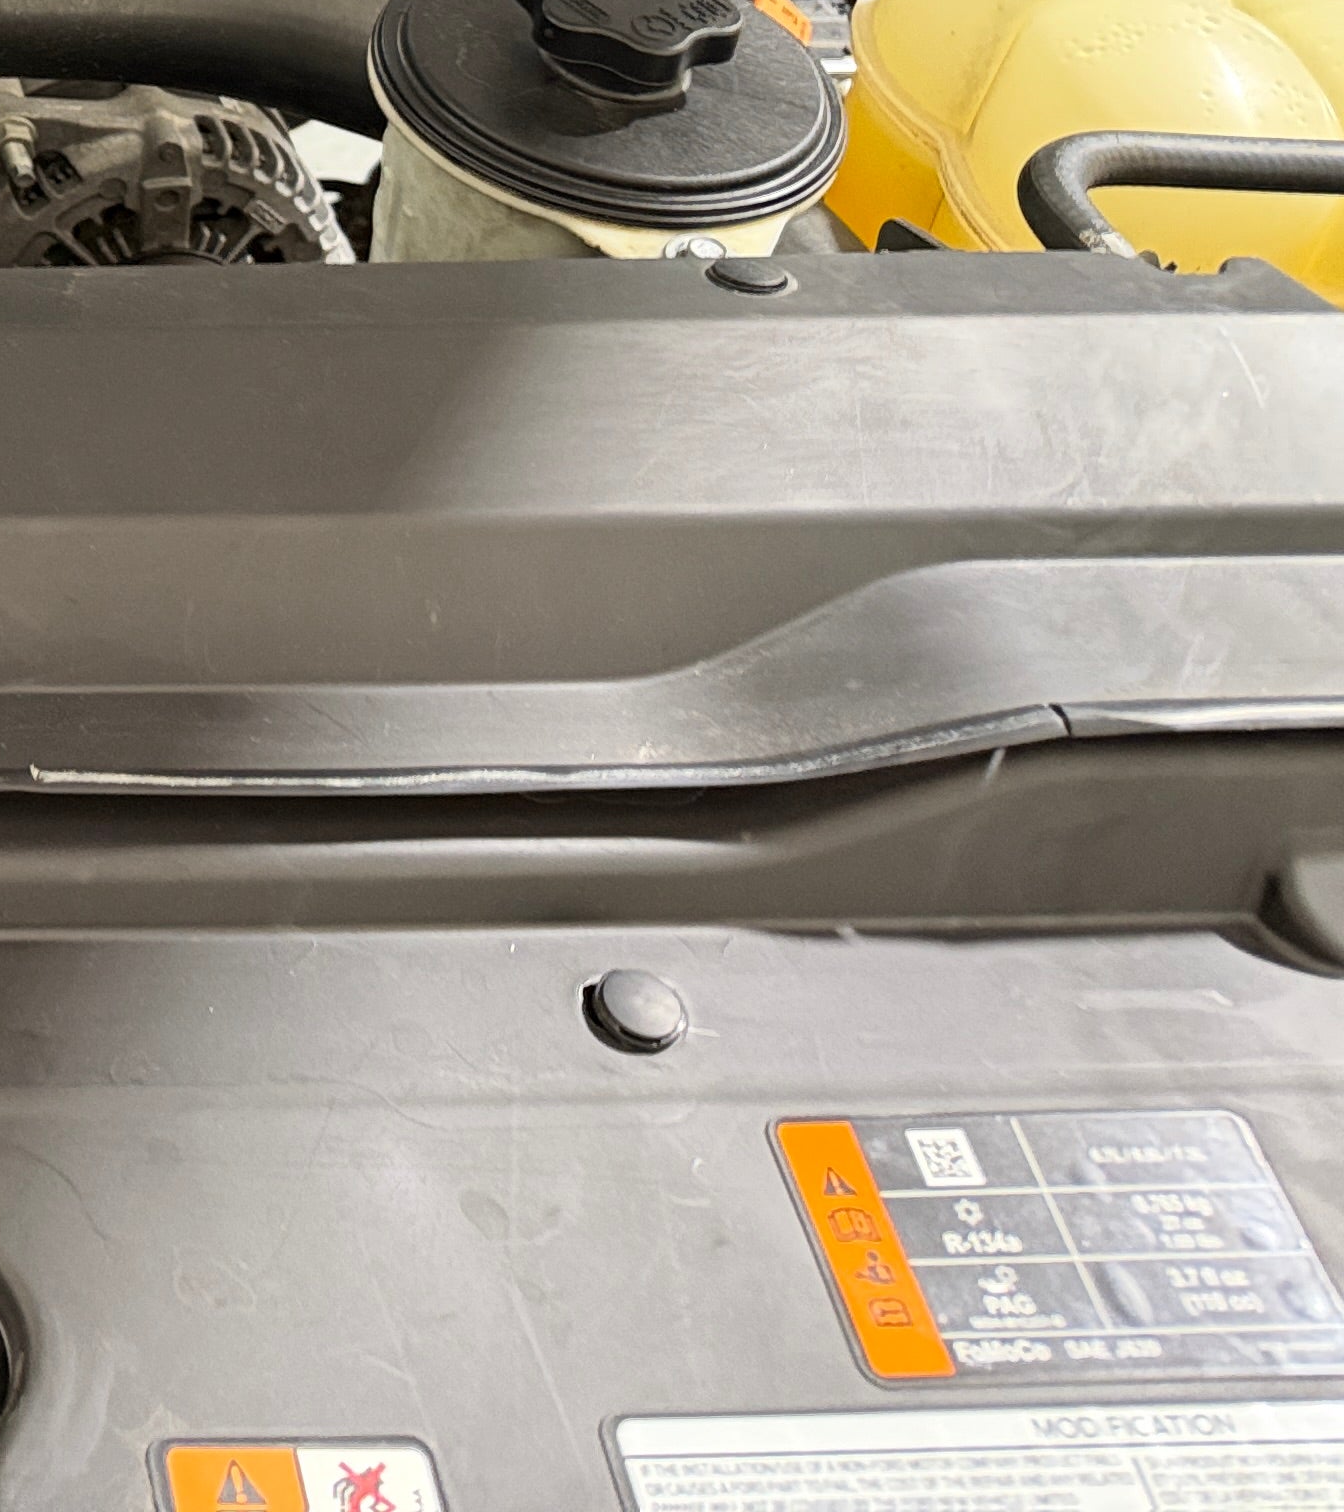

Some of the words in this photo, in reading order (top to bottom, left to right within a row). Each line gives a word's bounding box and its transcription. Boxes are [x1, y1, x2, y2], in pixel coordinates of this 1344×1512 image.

[941, 1230, 1023, 1255] R-134a
[982, 1292, 1037, 1316] PAG
[953, 1339, 1053, 1364] FoMoCo
